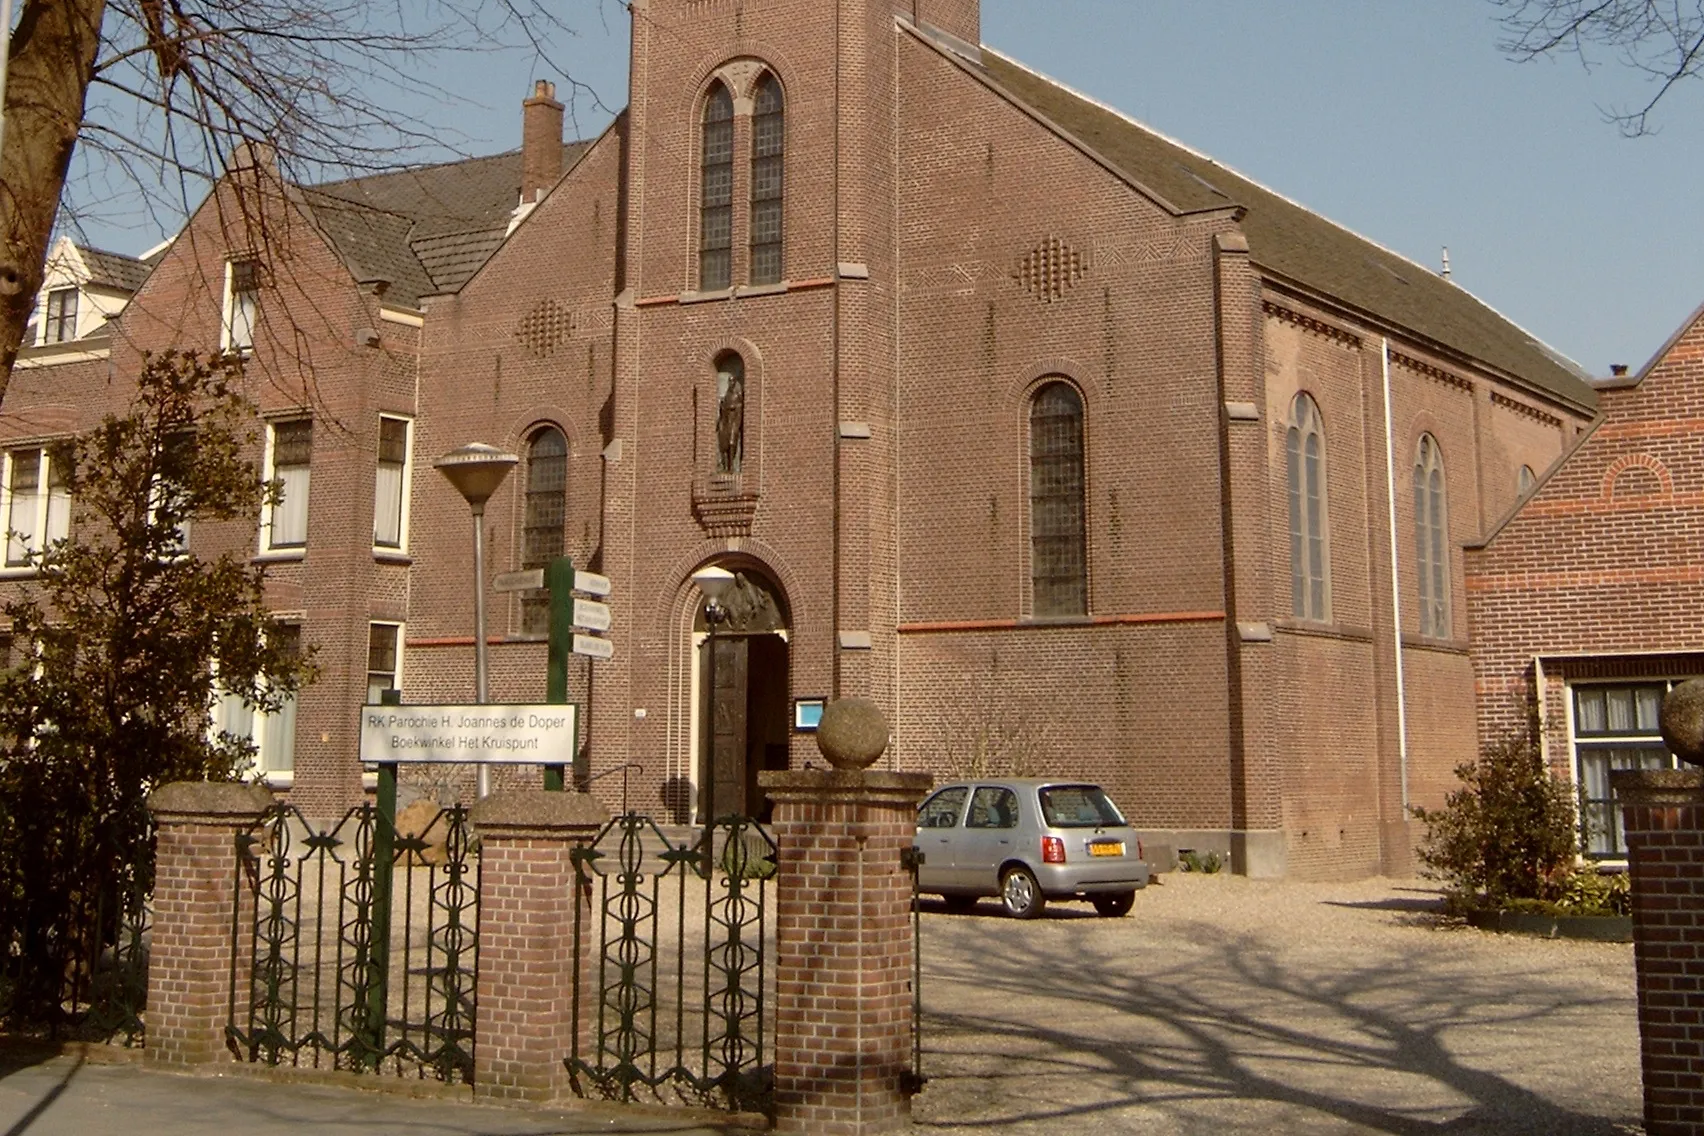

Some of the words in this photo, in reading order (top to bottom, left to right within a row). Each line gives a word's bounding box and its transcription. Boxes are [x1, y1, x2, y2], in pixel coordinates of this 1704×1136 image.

[368, 715, 385, 728] RK
[388, 715, 438, 728] Parochie
[441, 715, 453, 728] H.
[457, 715, 506, 728] Joannes
[510, 714, 525, 728] de
[528, 714, 566, 731] Doper
[391, 735, 455, 749] Boekwinkel
[458, 736, 479, 749] Het
[482, 736, 538, 752] Kruispunt
